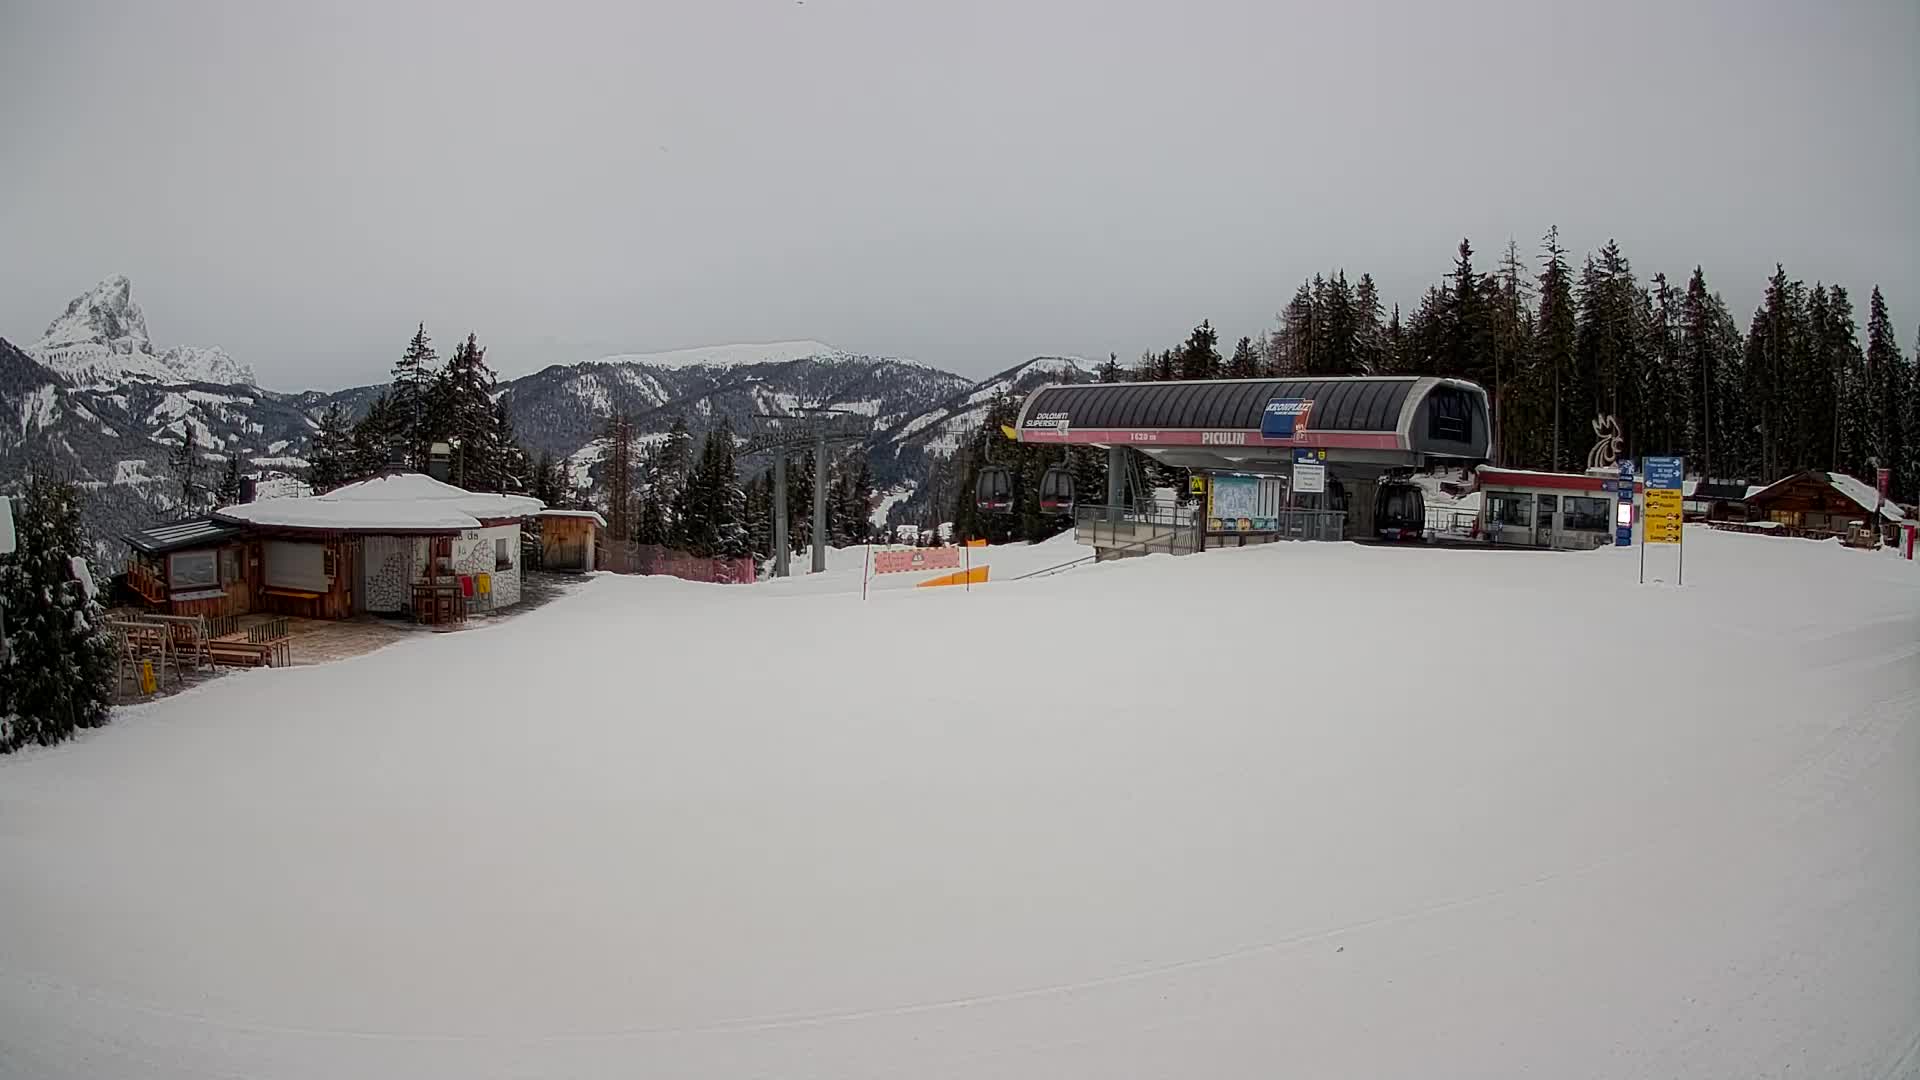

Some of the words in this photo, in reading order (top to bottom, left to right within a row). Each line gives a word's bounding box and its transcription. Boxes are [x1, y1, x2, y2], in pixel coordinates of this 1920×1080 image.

[1266, 403, 1312, 411] KRONPLATZ
[1036, 412, 1068, 420] DOLOMITI
[1130, 433, 1148, 441] 1620
[1202, 432, 1245, 445] PICULIN
